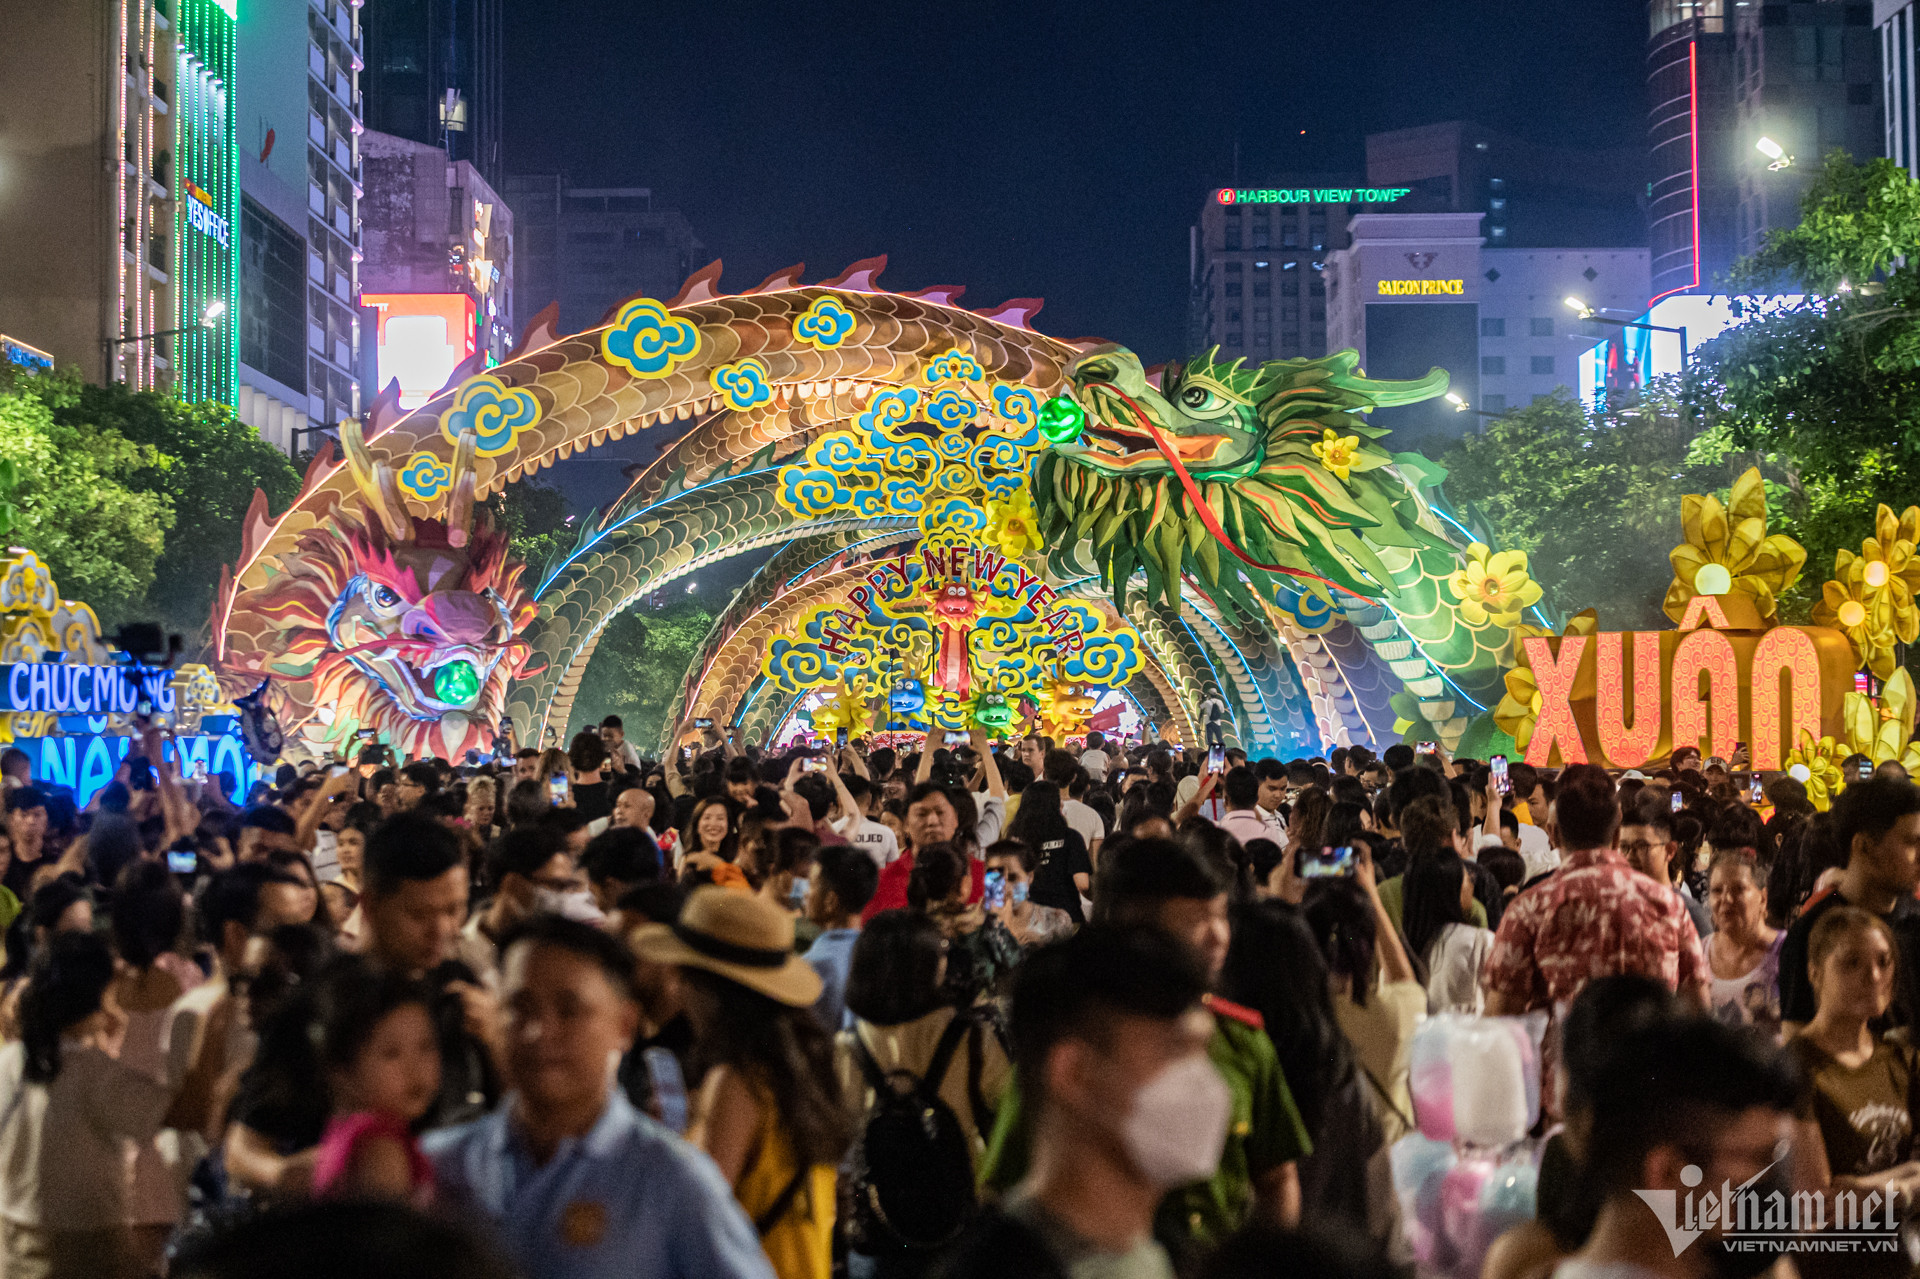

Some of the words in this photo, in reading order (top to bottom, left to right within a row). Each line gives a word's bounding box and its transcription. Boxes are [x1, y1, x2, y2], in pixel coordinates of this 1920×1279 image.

[1236, 190, 1310, 203] HARBOUR
[1313, 189, 1352, 203] VIEW
[1378, 280, 1420, 295] SAIGON
[1421, 280, 1464, 295] PRINCE
[818, 554, 911, 656] HAPPY
[923, 546, 1006, 584] NEW
[1013, 568, 1085, 654] YEAR
[1522, 595, 1821, 771] XUÂN
